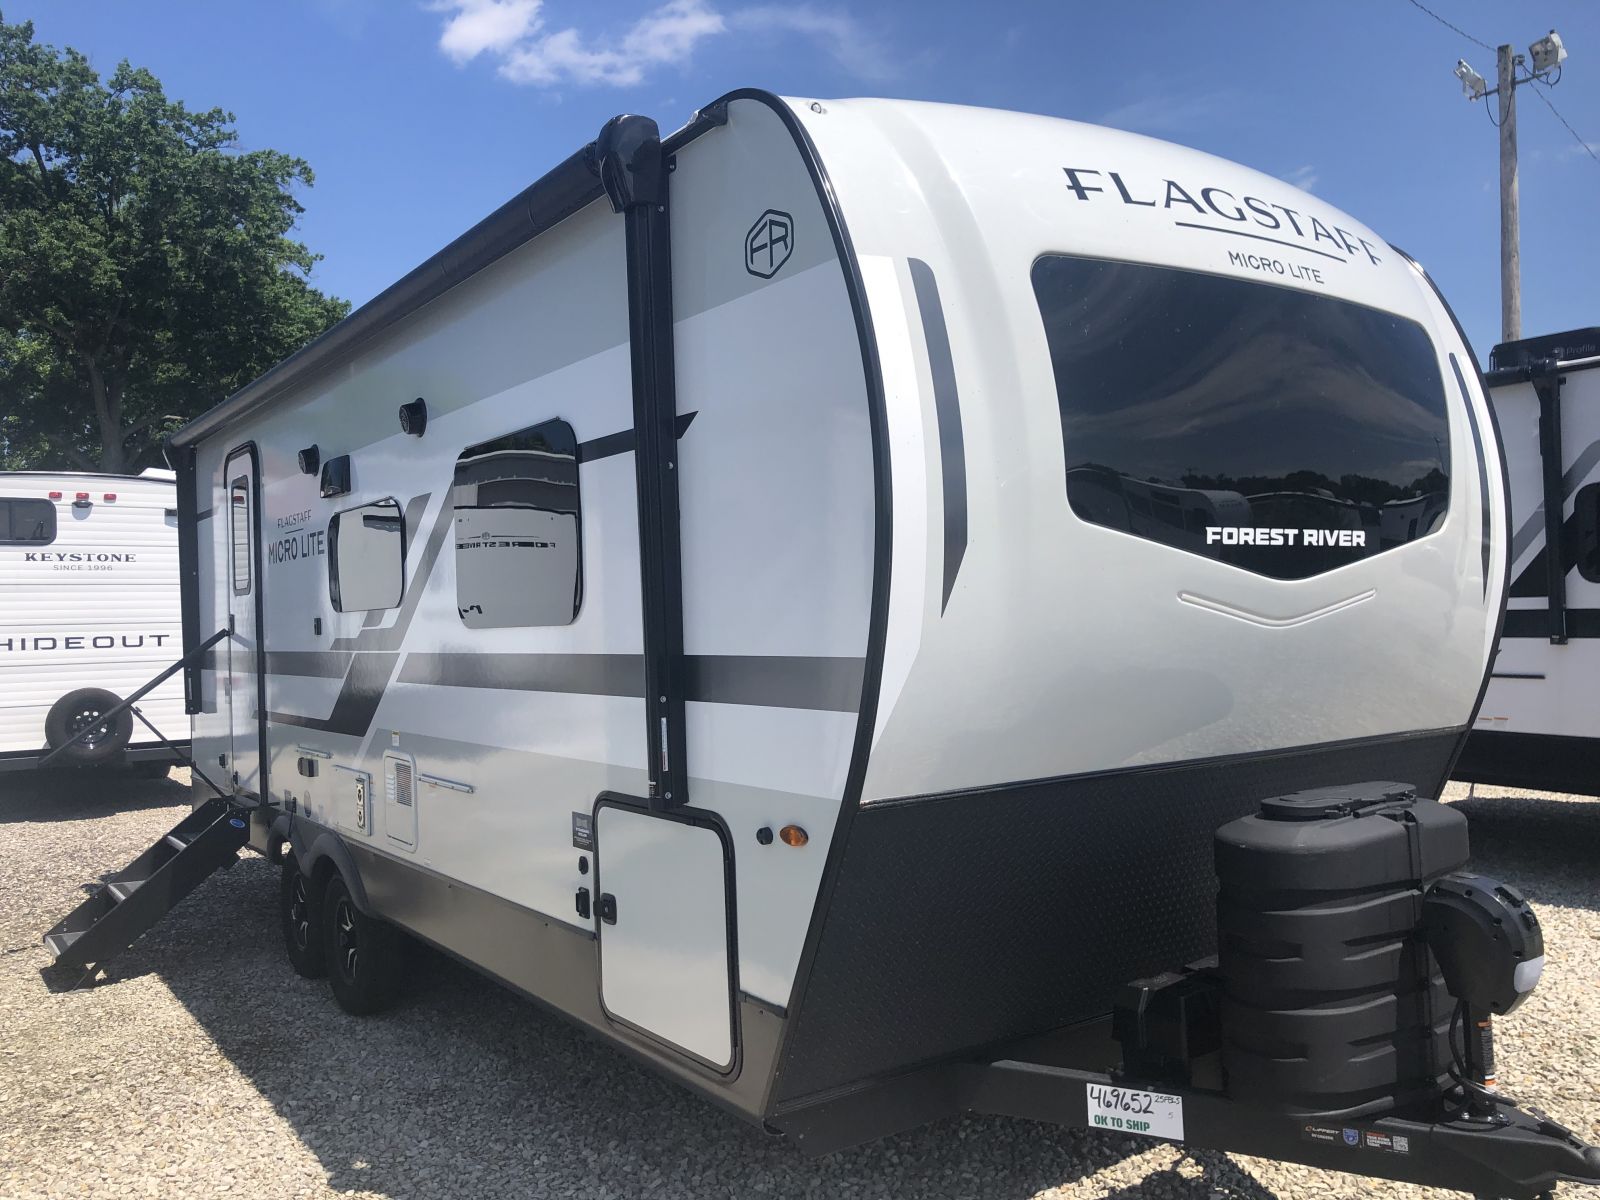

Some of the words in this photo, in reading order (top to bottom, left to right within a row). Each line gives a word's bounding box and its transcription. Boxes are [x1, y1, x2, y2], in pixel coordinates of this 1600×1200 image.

[1062, 167, 1382, 266] FLAGSTAFF
[1227, 250, 1285, 275] MICRO
[1289, 262, 1325, 284] LITE
[277, 509, 312, 528] FLAGSTAFF
[268, 537, 298, 565] MICRO
[301, 530, 325, 558] LITE
[1205, 526, 1299, 546] FOREST
[1302, 528, 1366, 547] RIVER
[24, 552, 137, 563] KEYSTONE
[1089, 1085, 1154, 1115] 469652
[1093, 1114, 1108, 1126] OK
[1110, 1116, 1123, 1128] TO
[1126, 1119, 1150, 1132] SHIP
